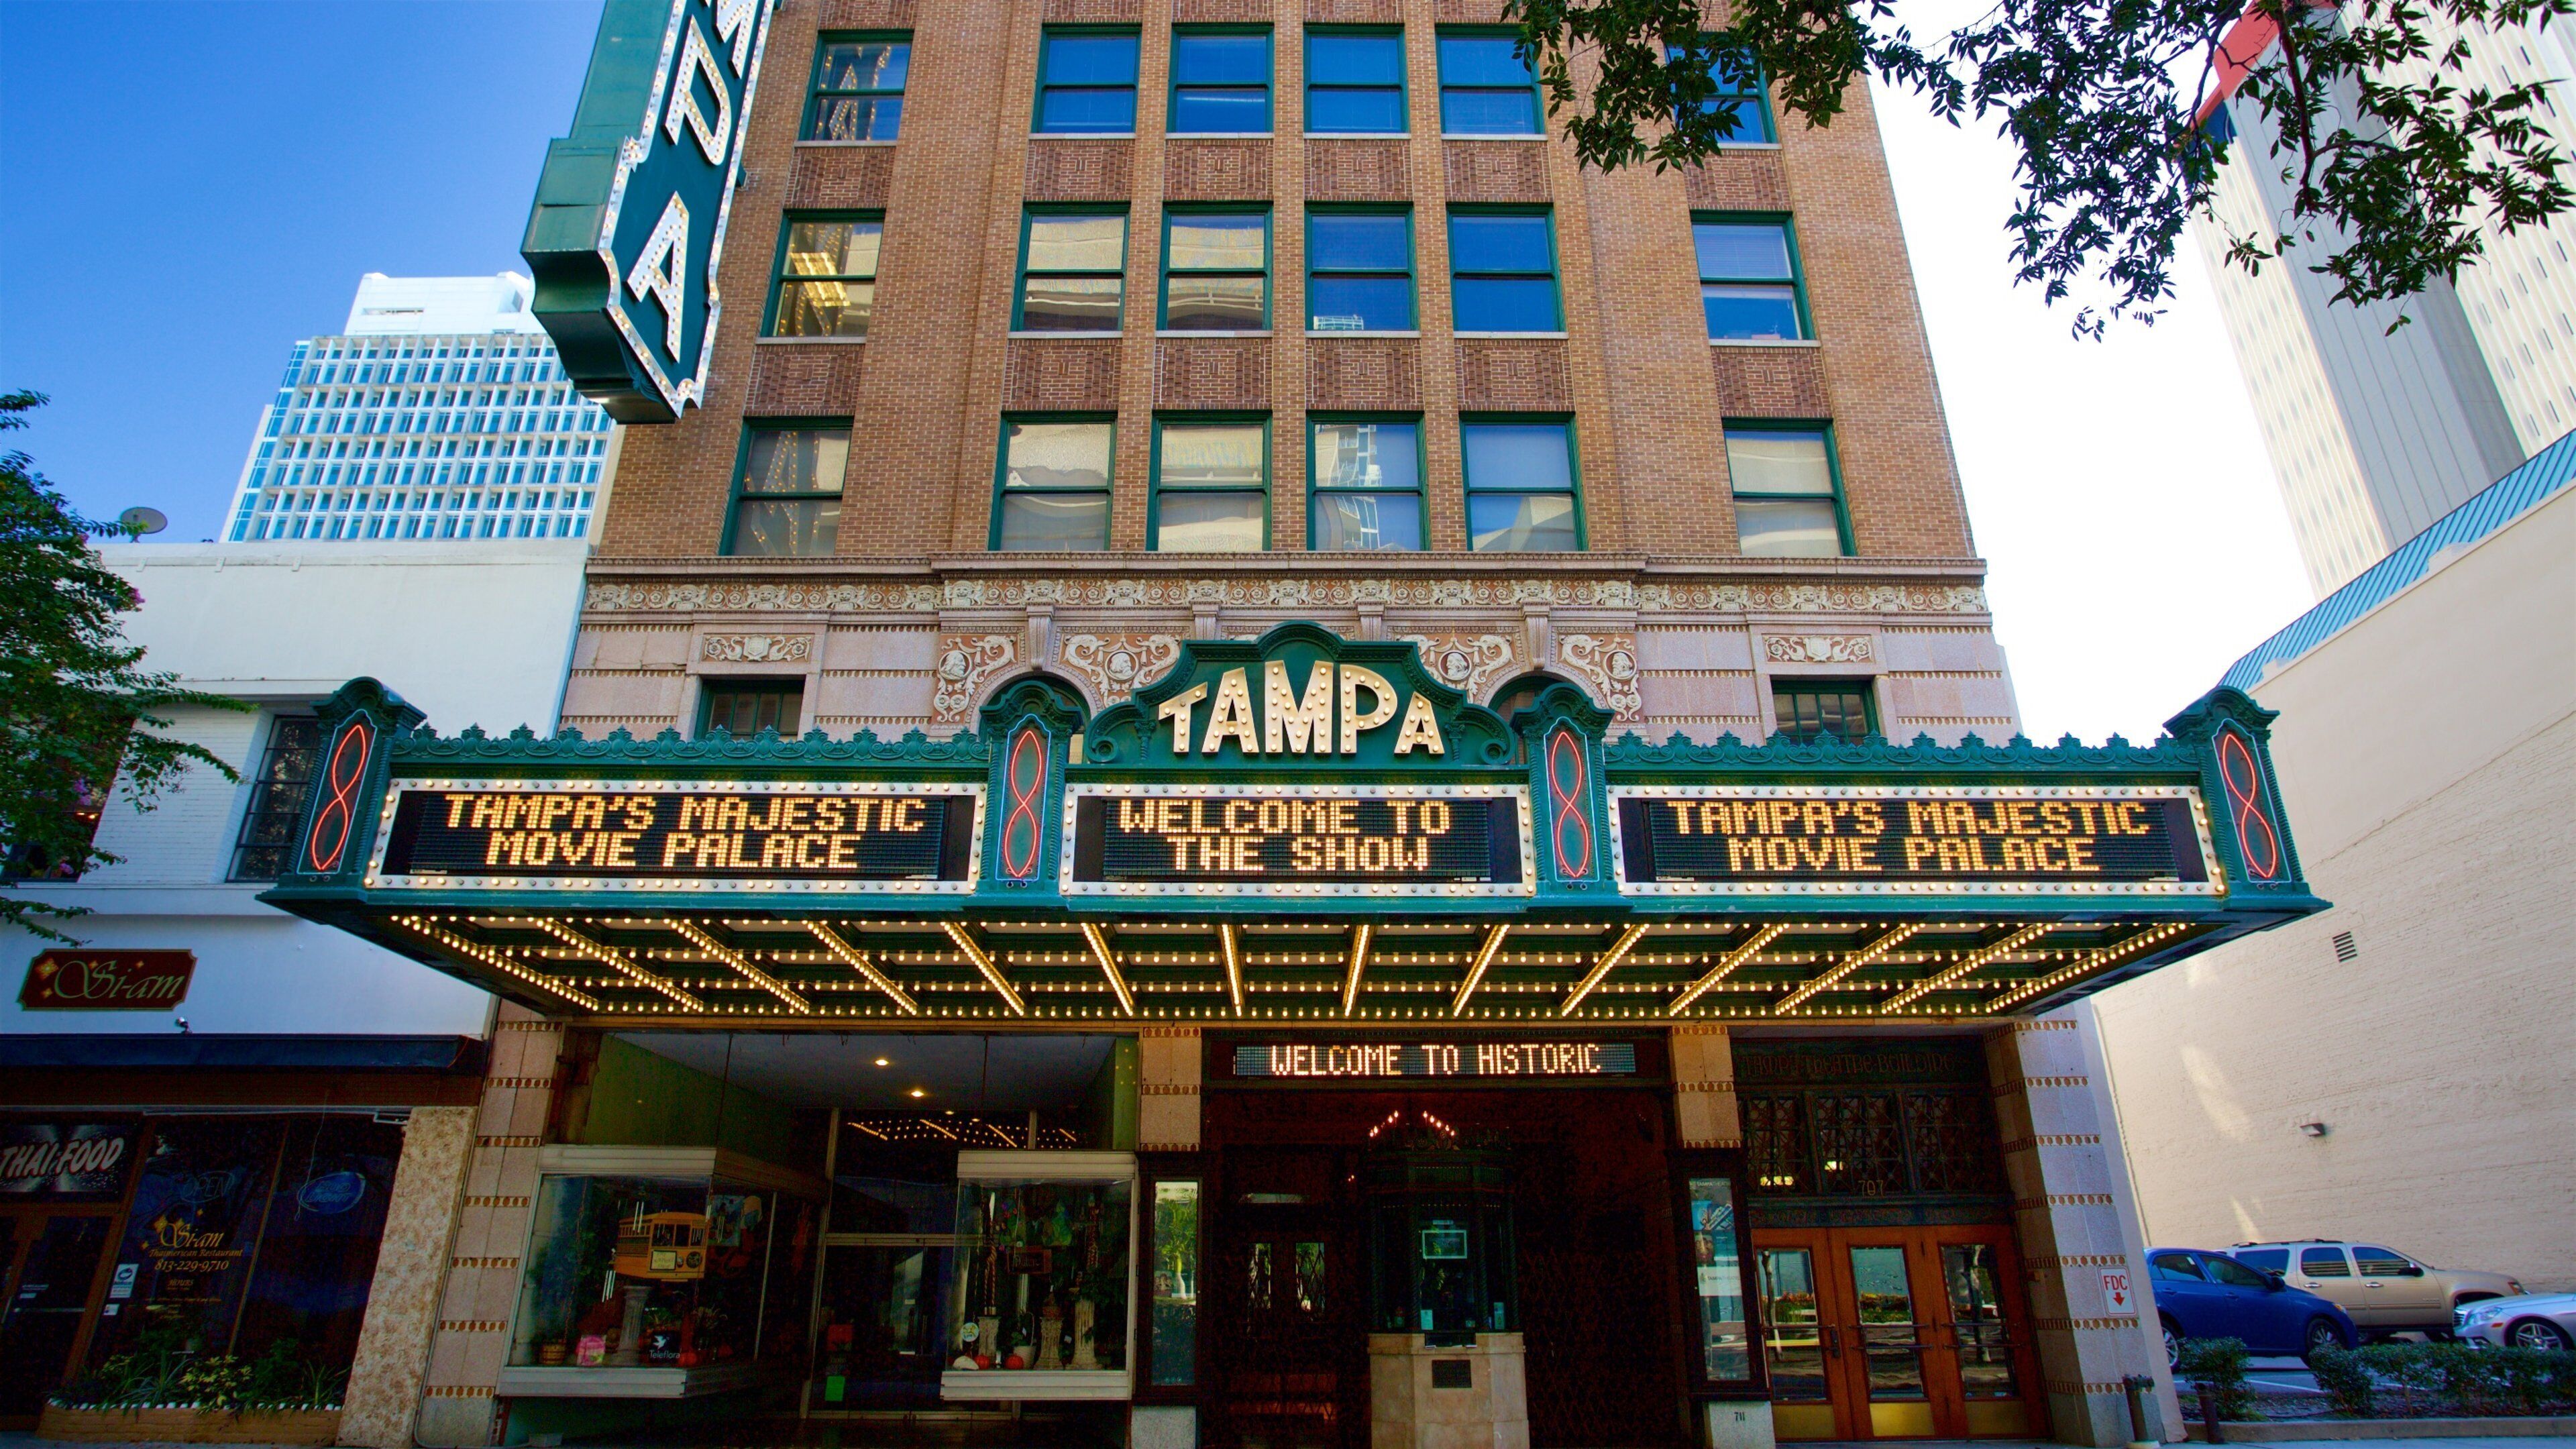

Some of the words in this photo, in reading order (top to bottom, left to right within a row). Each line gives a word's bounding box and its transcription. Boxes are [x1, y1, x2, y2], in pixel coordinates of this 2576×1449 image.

[1159, 660, 1445, 754] TAMPA
[445, 794, 656, 830] TAMPA'S
[679, 796, 926, 832] MAJESTIC
[1118, 800, 1360, 834] WELCOME
[1387, 800, 1451, 835] TO
[1667, 801, 1885, 835] TAMPA'S
[1907, 801, 2150, 835] MAJESTIC
[485, 831, 641, 867] MOVIE
[663, 833, 861, 868] PALACE
[1167, 837, 1265, 871] THE
[1292, 837, 1428, 872] SHOW
[1728, 837, 1883, 871] MOVIE
[1904, 837, 2100, 871] PALACE
[54, 960, 185, 999] Si-am
[1271, 1044, 1403, 1075] WELCOME
[1421, 1044, 1459, 1075] TO
[1478, 1043, 1601, 1074] HISTORIC
[0, 1142, 60, 1179] THAI
[55, 1137, 125, 1174] FOOD
[1858, 1180, 1884, 1197] 707
[154, 1258, 229, 1273] 813-229-9710
[200, 1248, 244, 1258] Restaurant
[2103, 1275, 2128, 1291] FDC
[649, 1348, 681, 1358] Teleflora
